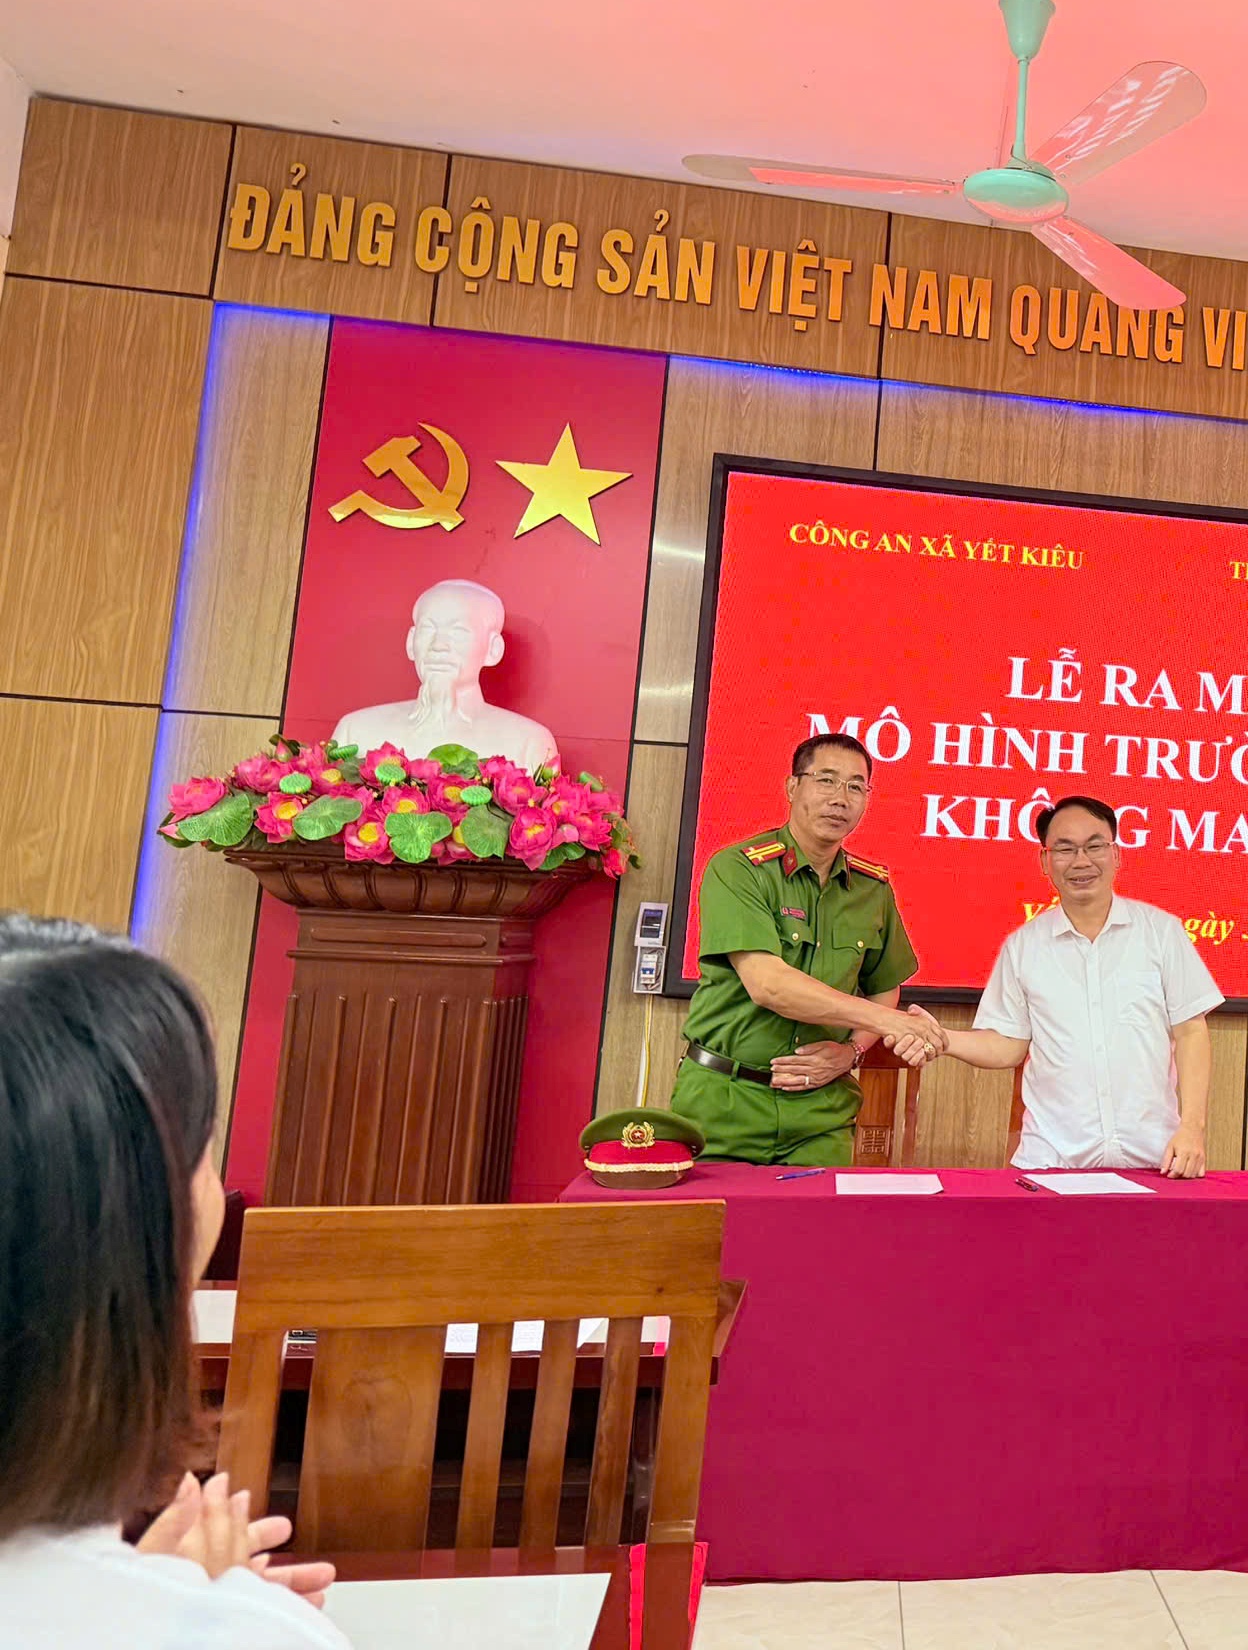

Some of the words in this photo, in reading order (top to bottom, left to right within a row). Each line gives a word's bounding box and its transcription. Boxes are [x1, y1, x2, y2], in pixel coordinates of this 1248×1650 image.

[227, 163, 396, 268] ĐẢNG
[415, 196, 578, 292] CỘNG
[597, 209, 715, 305] SẢN
[737, 239, 852, 332] VIỆT
[869, 263, 992, 341] NAM
[1009, 284, 1185, 363] QUANG
[789, 520, 869, 549] CÔNG
[873, 533, 912, 553] AN
[919, 535, 956, 558] XÃ
[963, 538, 1015, 563] YẾT
[1020, 543, 1084, 569] KIÊU
[1006, 647, 1083, 704] LỄ
[1099, 664, 1181, 711] RA
[930, 712, 1088, 775] HÌNH
[920, 787, 1151, 848] KHÔG
[1184, 911, 1235, 946] gày
